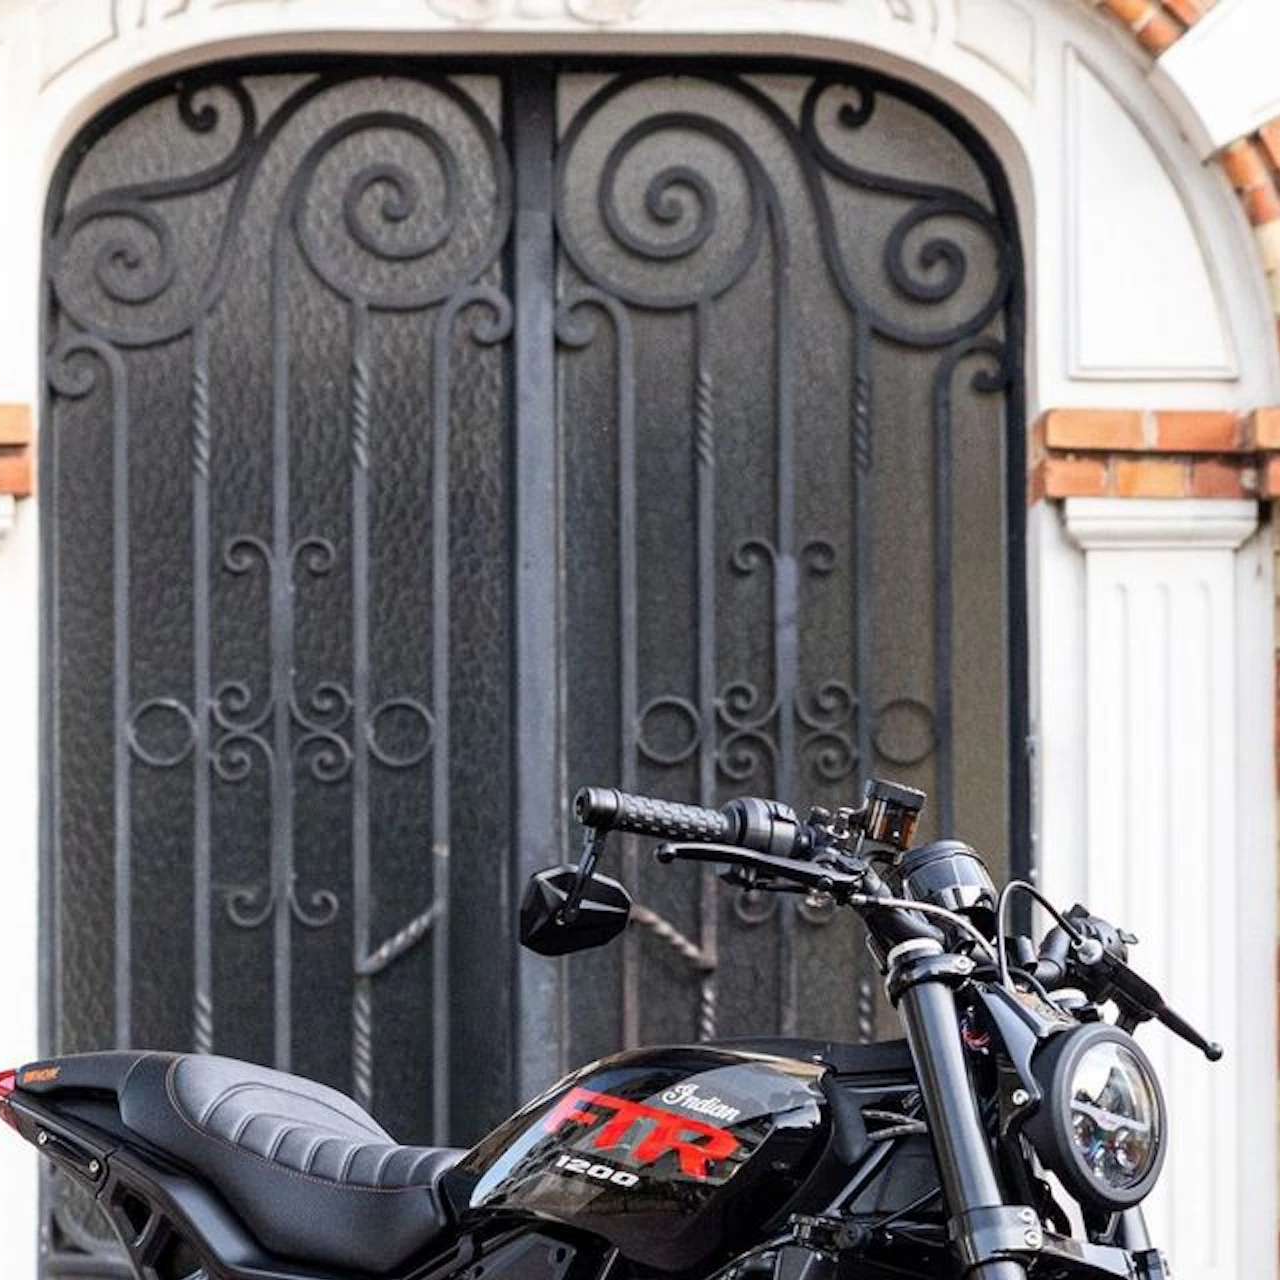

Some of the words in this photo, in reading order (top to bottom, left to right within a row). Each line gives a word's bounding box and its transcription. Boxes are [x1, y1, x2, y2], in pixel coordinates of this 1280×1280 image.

[661, 1082, 741, 1122] Indian
[543, 1086, 740, 1179] FTR
[555, 1154, 640, 1188] 1200
